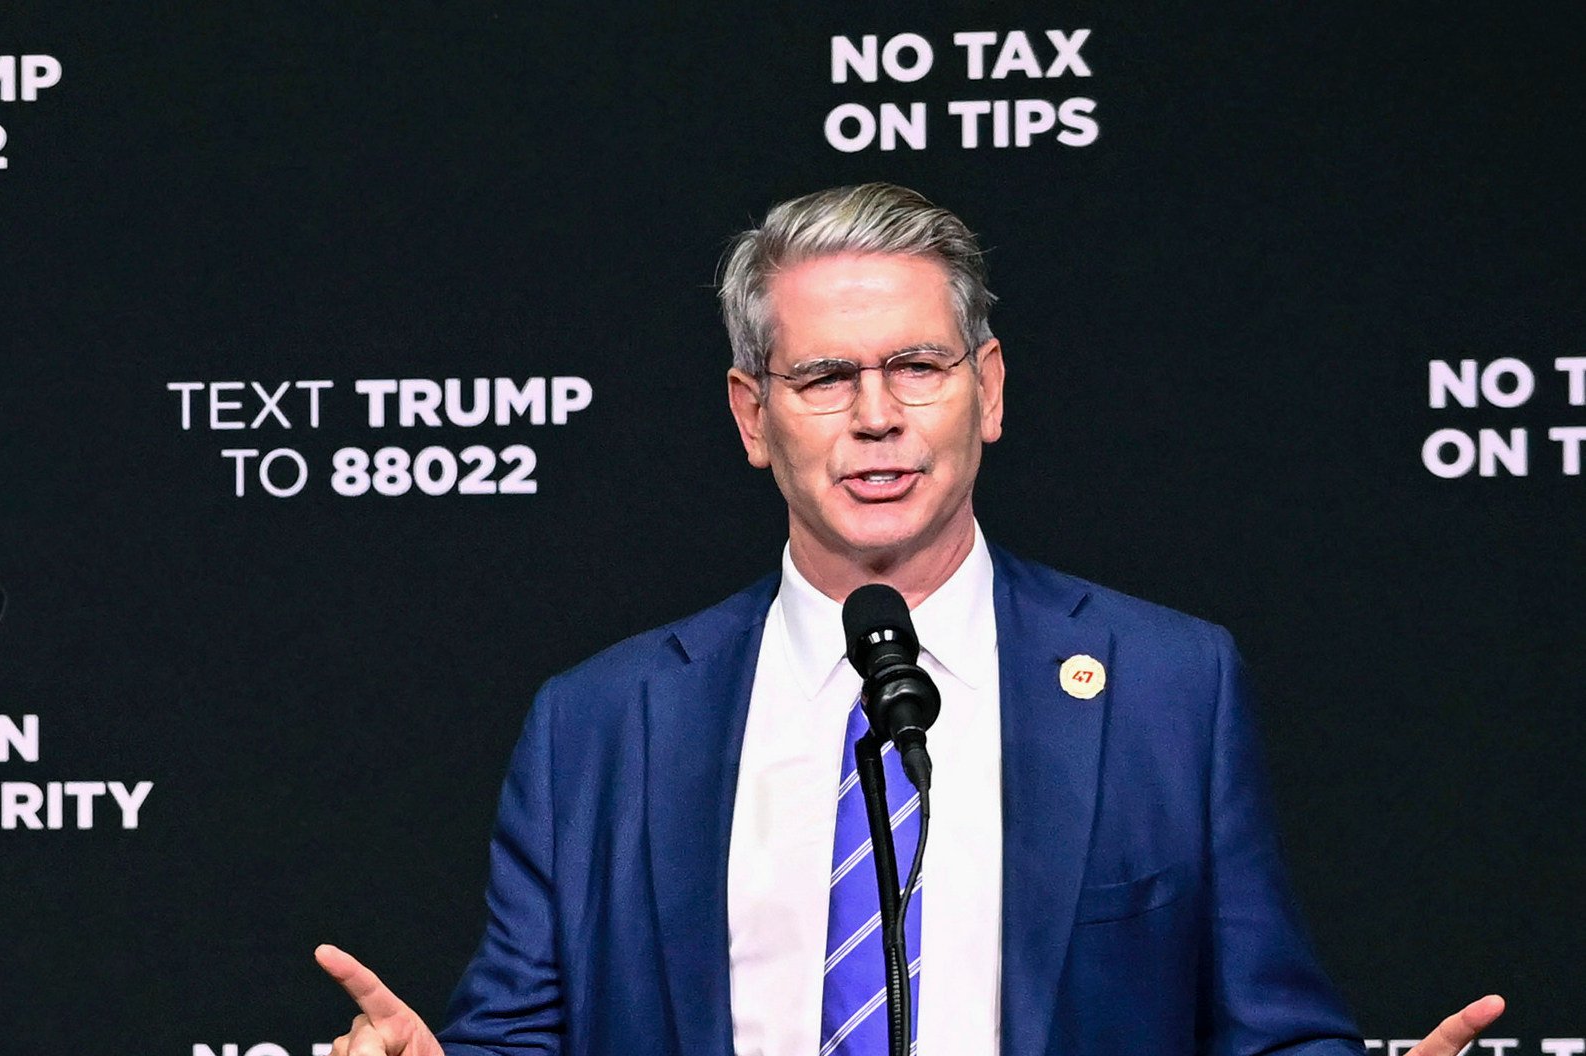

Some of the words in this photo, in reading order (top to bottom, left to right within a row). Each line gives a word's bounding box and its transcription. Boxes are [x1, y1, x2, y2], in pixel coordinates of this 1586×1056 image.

[831, 32, 934, 84] NO
[953, 28, 1092, 80] TAX
[824, 101, 927, 153] ON
[947, 96, 1099, 149] TIPS
[166, 379, 334, 430] TEXT
[354, 376, 593, 428] TRUMP
[1428, 357, 1535, 409] NO
[220, 447, 308, 498] TO
[330, 444, 538, 497] 88022
[1421, 427, 1528, 479] ON
[1071, 670, 1094, 683] 47
